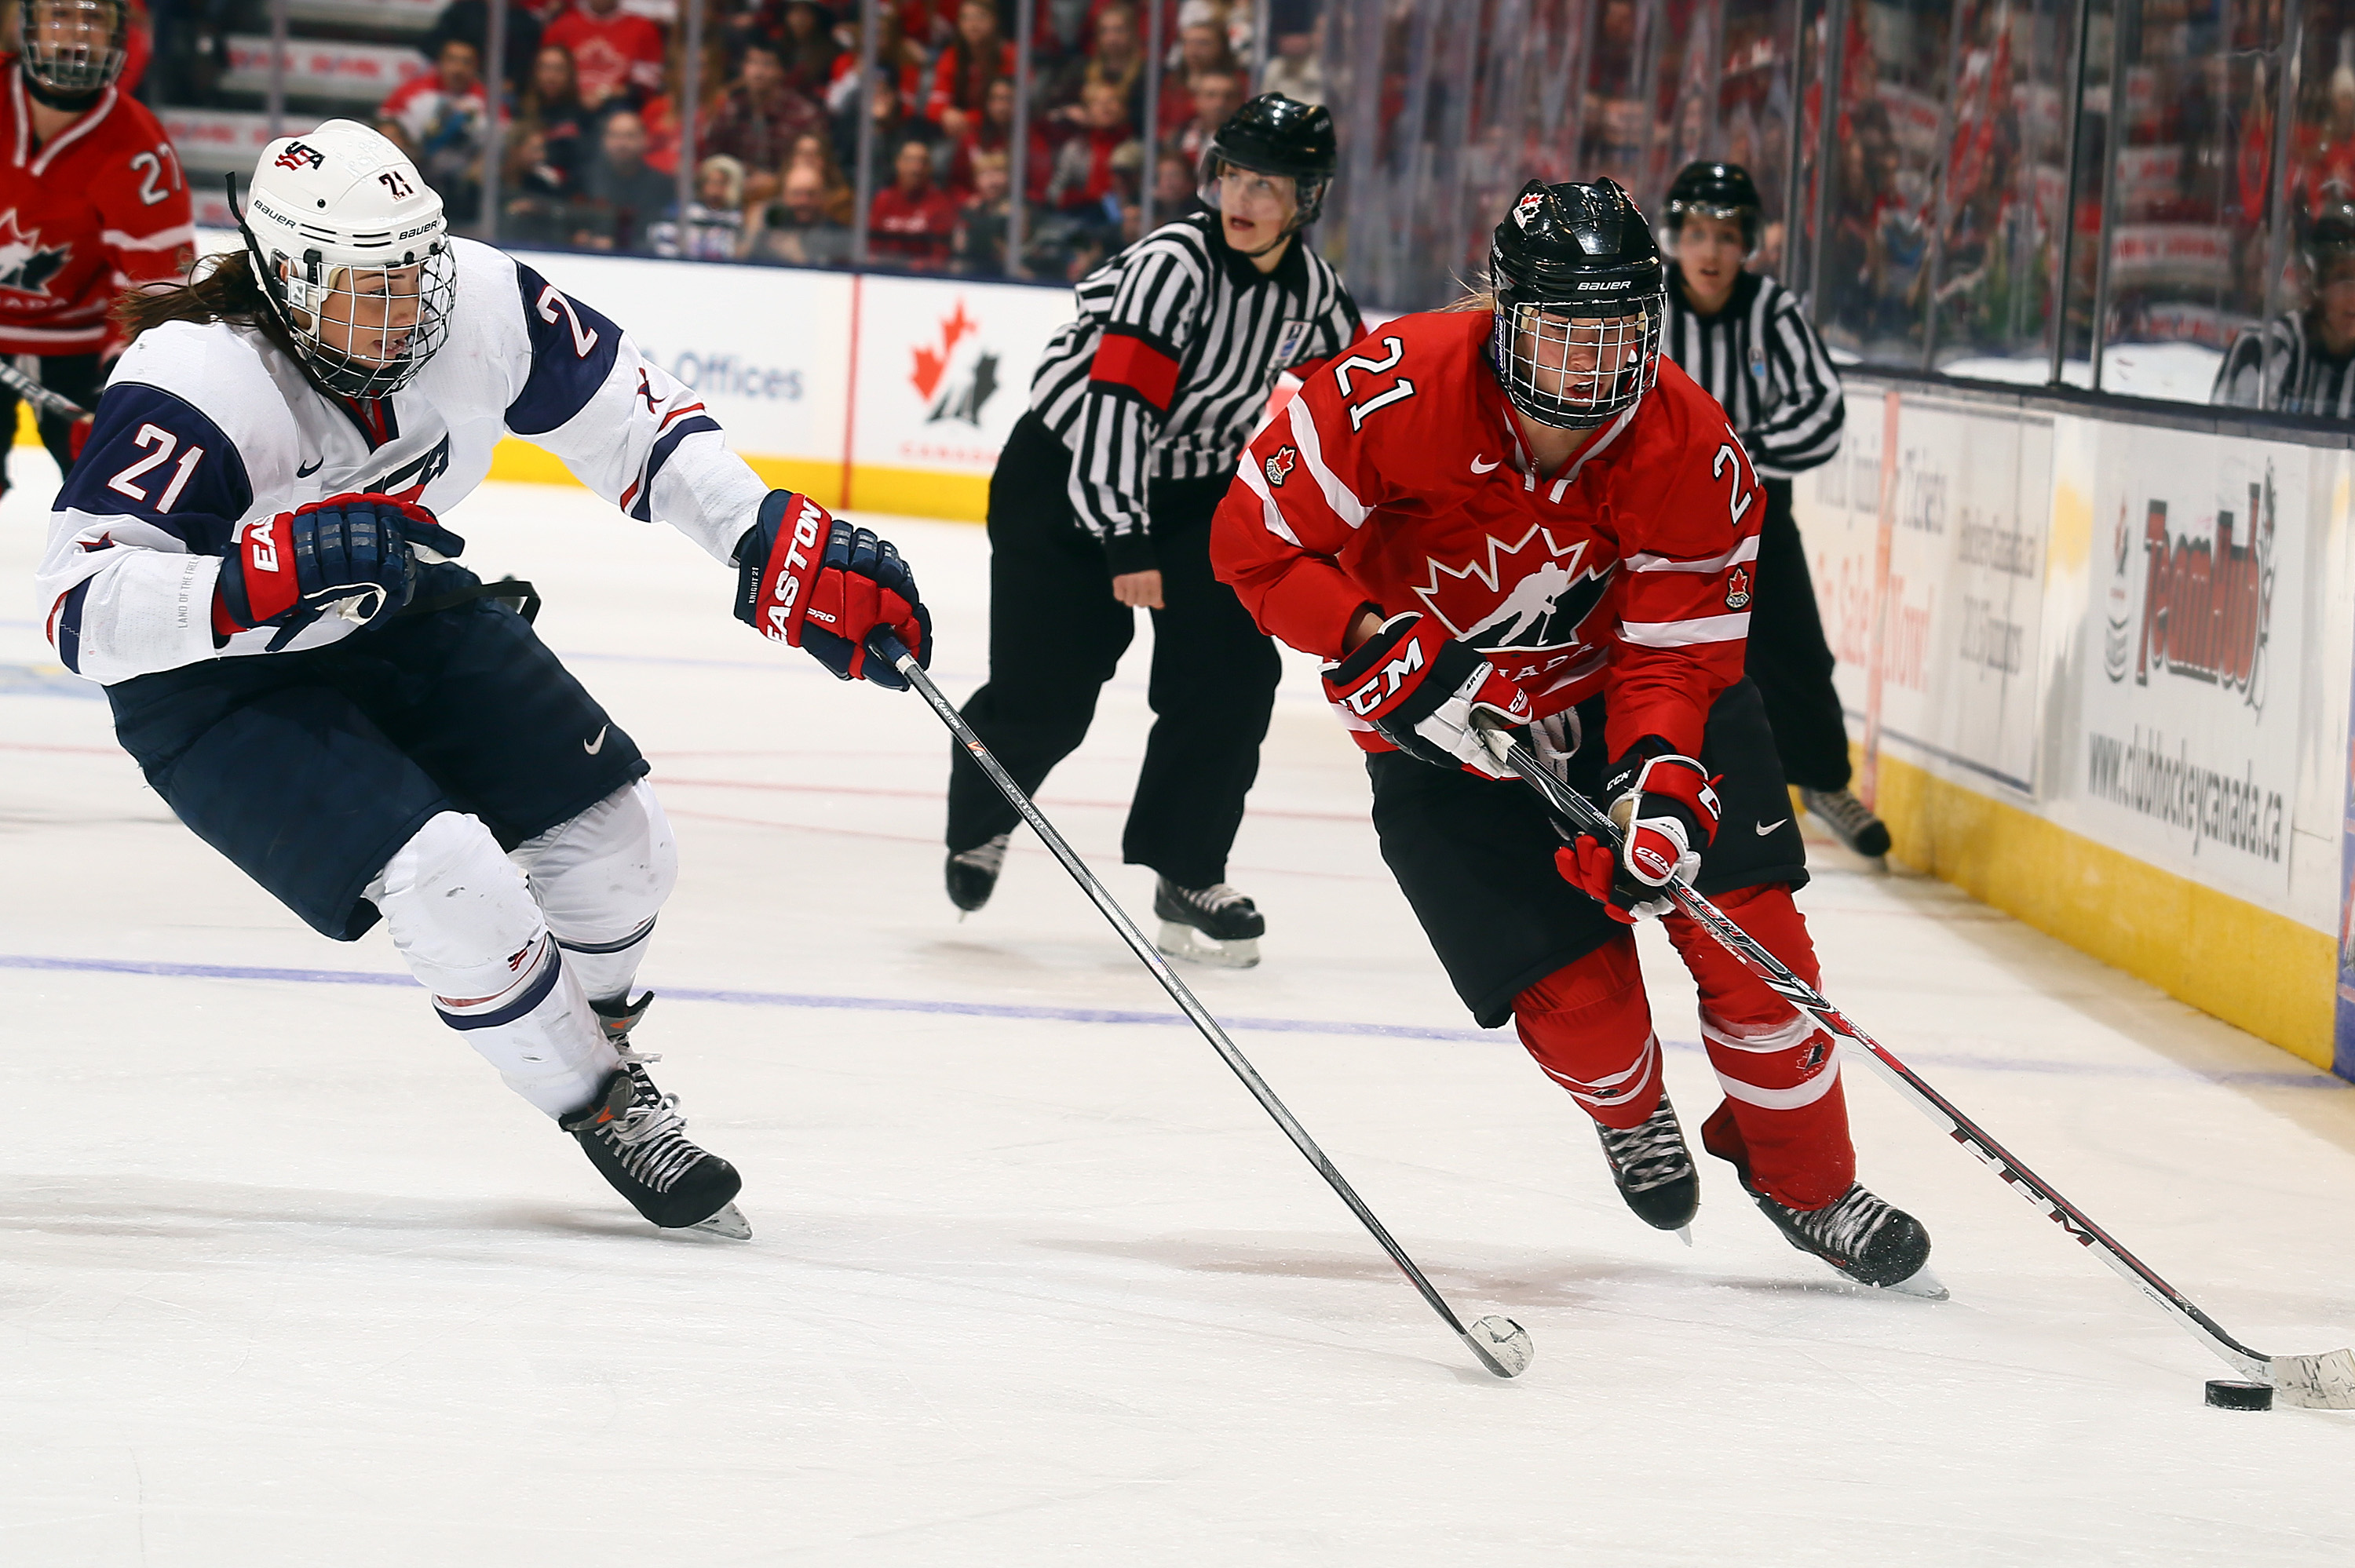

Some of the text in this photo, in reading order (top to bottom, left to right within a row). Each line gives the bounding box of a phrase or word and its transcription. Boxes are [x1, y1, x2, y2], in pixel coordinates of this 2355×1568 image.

[275, 141, 325, 170] USA
[378, 170, 415, 200] 21
[254, 199, 297, 229] BAUER
[397, 220, 438, 240] BAUER
[1577, 281, 1631, 291] BAUER
[674, 351, 804, 401] Offices
[1334, 337, 1414, 432] 21
[107, 422, 206, 514] 21
[181, 575, 194, 589] THE
[748, 567, 759, 604] KNIGHT 21
[767, 495, 823, 646] EASTON
[179, 593, 189, 603] OF
[177, 605, 188, 629] LAND
[1338, 637, 1426, 716] CM
[937, 702, 962, 730] EASTON
[2088, 724, 2282, 863] www.clubhockeycanada.ca
[1593, 811, 1614, 828] IRWIN
